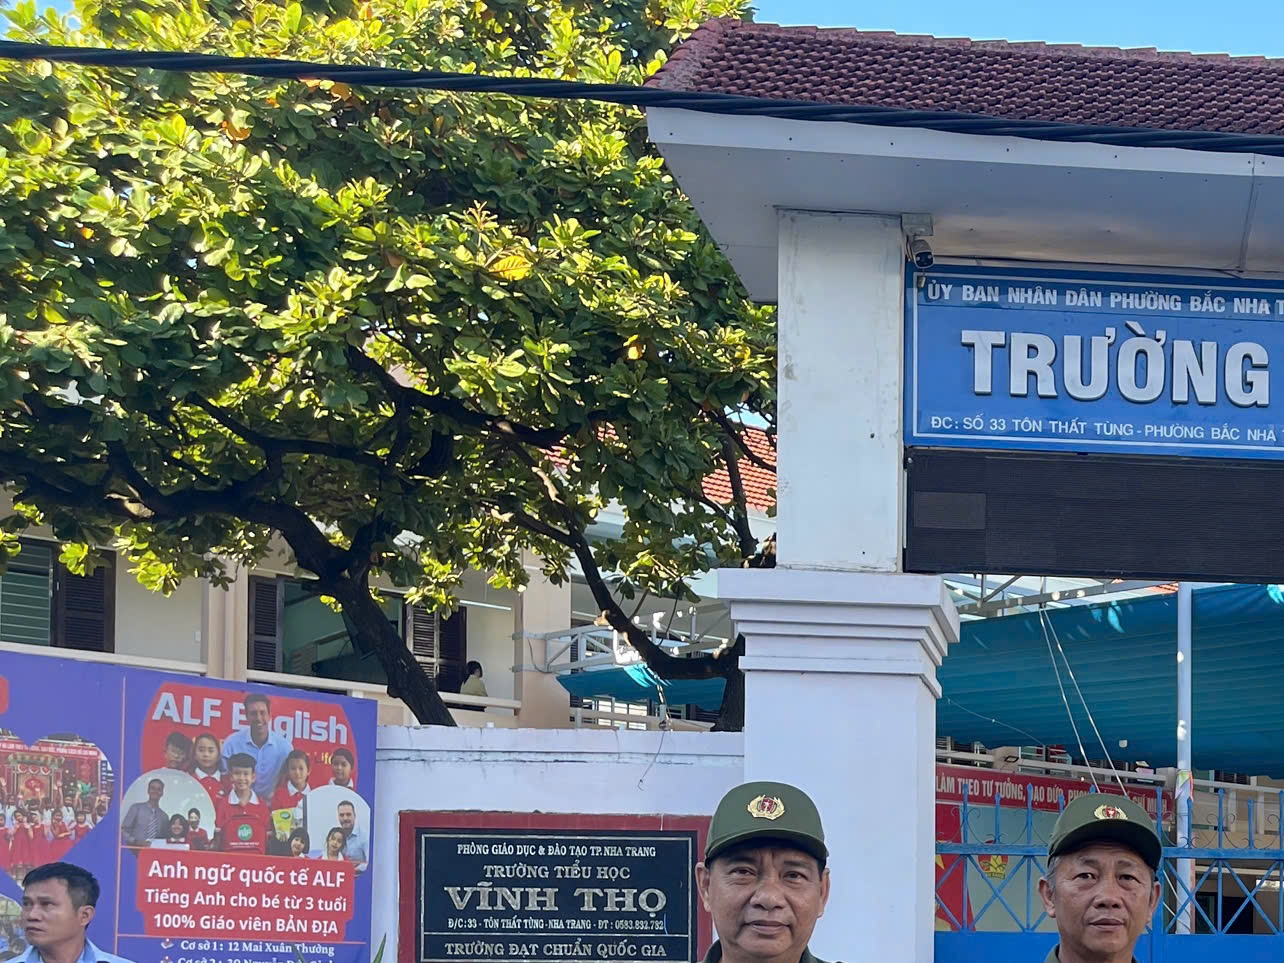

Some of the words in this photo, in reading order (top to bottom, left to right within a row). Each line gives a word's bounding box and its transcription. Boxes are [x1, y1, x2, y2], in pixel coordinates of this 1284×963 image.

[927, 280, 953, 300] ỦY
[961, 285, 999, 302] BAN
[1008, 286, 1057, 305] NHÂN
[1065, 287, 1102, 307] DÂN
[1110, 290, 1181, 311] PHƯỜNG
[1190, 290, 1225, 313] BẮC
[1233, 298, 1271, 315] NHA
[961, 321, 1270, 407] TRƯỜNG
[963, 412, 984, 430] SỐ
[990, 418, 1006, 431] 33
[1012, 417, 1043, 433] TÔN
[1049, 417, 1087, 434] THẤT
[1094, 419, 1134, 436] TÙNG
[1144, 423, 1205, 439] PHƯỜNG
[1211, 423, 1240, 440] BẮC
[1247, 428, 1277, 442] NHA
[152, 692, 222, 727] ALF
[232, 702, 348, 745] Eglish
[1027, 784, 1044, 806] ẠO
[457, 841, 489, 855] PHÒNG
[492, 842, 514, 855] GIÁO
[516, 844, 536, 857] DỤC
[538, 845, 545, 855] &
[547, 842, 567, 855] ĐÀO
[569, 845, 587, 857] TẠO
[625, 847, 656, 857] TRANG
[148, 860, 188, 880] Anh
[195, 864, 235, 885] ngữ
[239, 866, 284, 887] quốc
[290, 868, 309, 886] tế
[313, 871, 345, 888] ALF
[483, 862, 550, 878] TRƯỜNG
[553, 859, 592, 879] TIỂU
[596, 866, 630, 881] HỌC
[145, 888, 189, 908] Tiếng
[194, 891, 226, 906] Anh
[230, 893, 257, 907] cho
[262, 894, 280, 909] bé
[284, 895, 303, 910] từ
[305, 897, 314, 910] 3
[318, 896, 347, 912] tuổi
[444, 881, 559, 911] VĨNH
[574, 887, 667, 917] THỌ
[154, 914, 196, 929] 100%
[200, 915, 235, 931] Giáo
[239, 917, 271, 932] viên
[276, 915, 308, 934] BẢN
[311, 919, 338, 937] ĐỊA
[484, 916, 500, 928] TÔN
[501, 915, 522, 928] THẤT
[565, 919, 592, 929] TRANG
[181, 940, 196, 950] Cơ
[228, 942, 239, 952] 12
[242, 941, 263, 952] Mai
[264, 942, 292, 953] Xuân
[444, 940, 505, 955] TRƯỜNG
[509, 943, 539, 957] ĐẠT
[543, 937, 592, 956] CHUẨN
[597, 939, 637, 958] QUỐC
[641, 944, 667, 957] GIA
